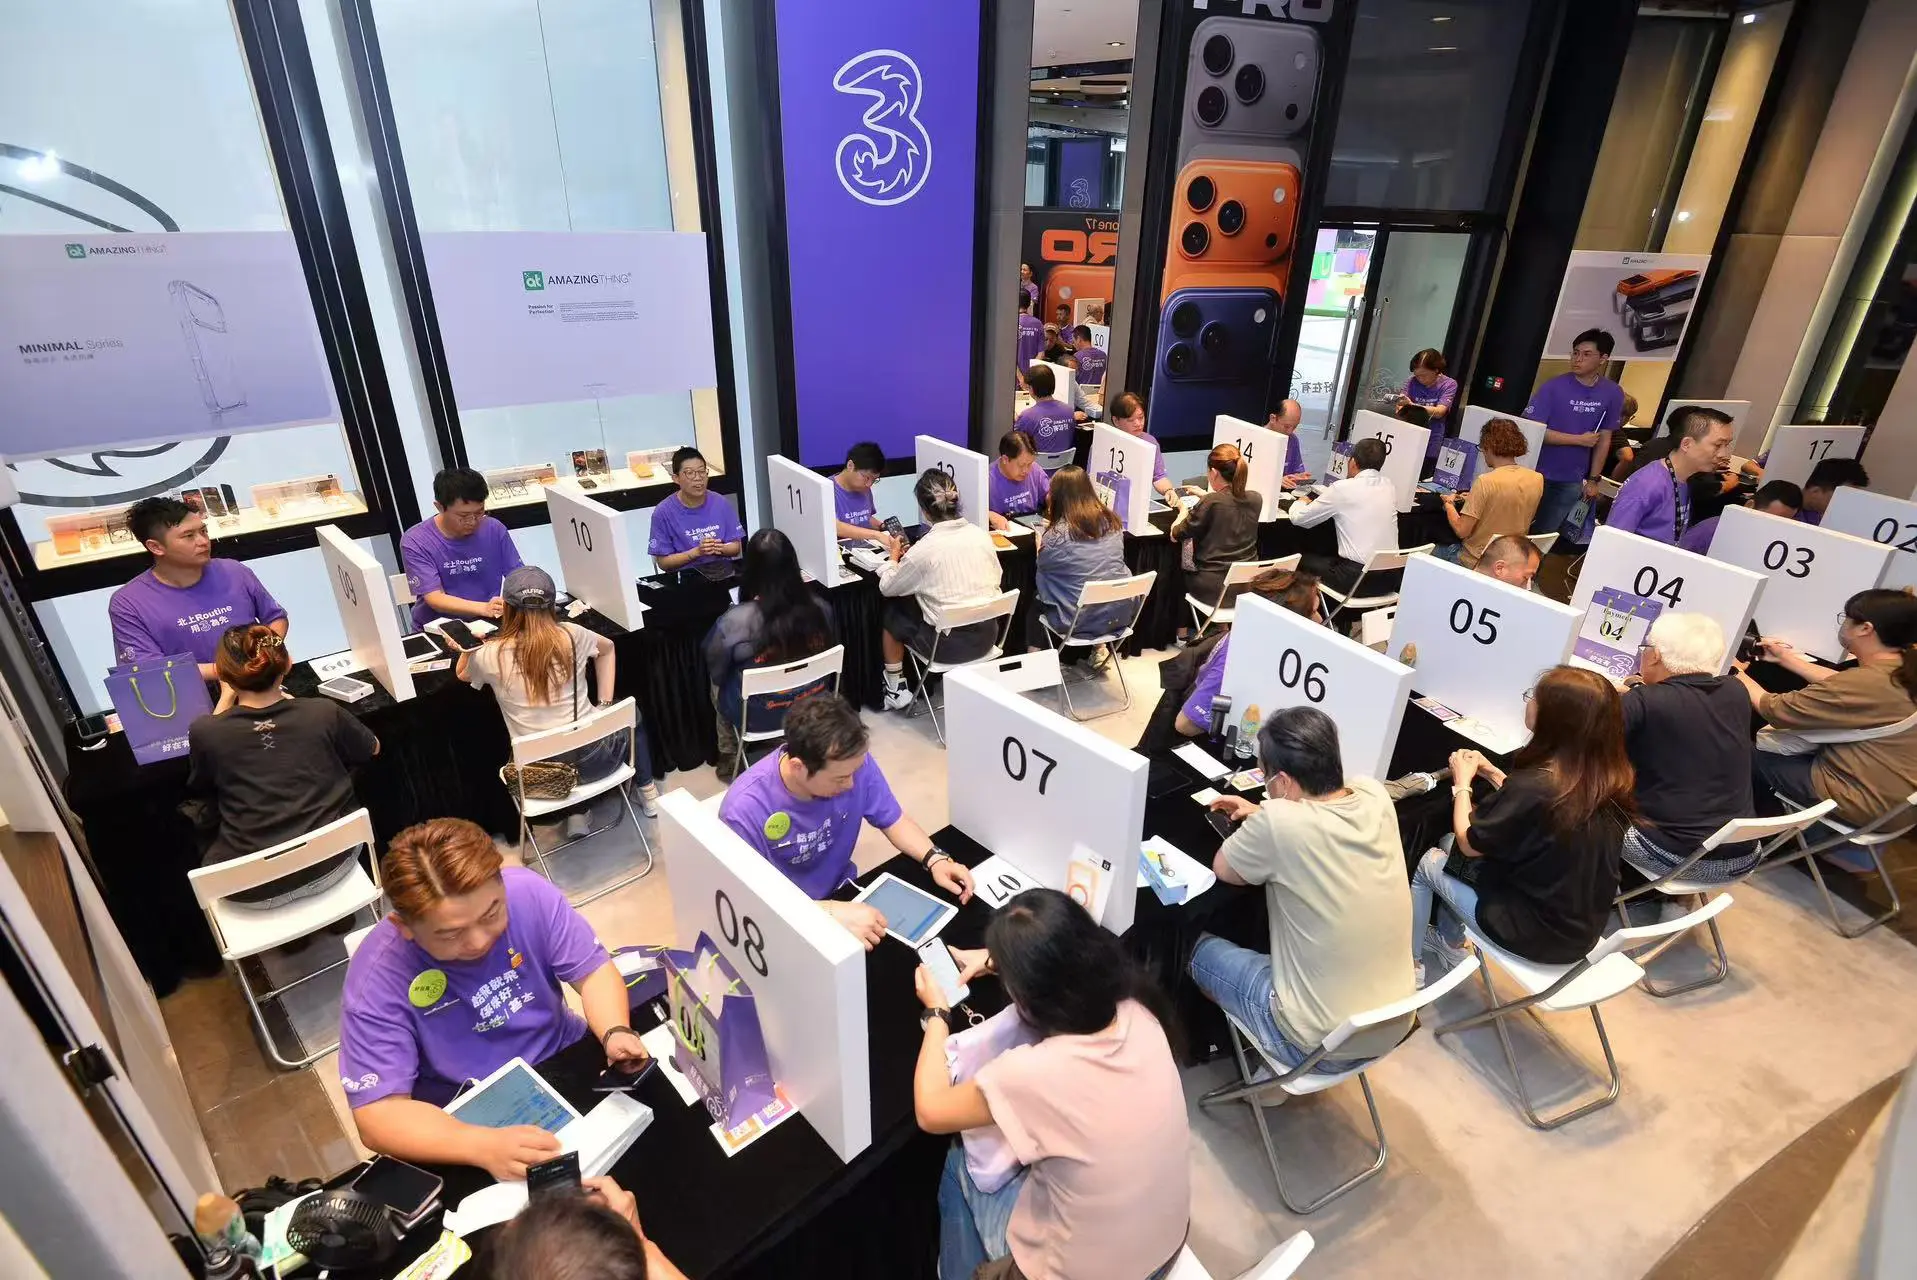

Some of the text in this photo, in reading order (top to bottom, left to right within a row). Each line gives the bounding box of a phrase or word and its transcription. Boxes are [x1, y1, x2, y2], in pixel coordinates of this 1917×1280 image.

[19, 339, 123, 354] MINIMAL Series
[1110, 447, 1125, 474] 13
[1236, 438, 1253, 463] 14
[1444, 457, 1456, 469] 16
[1809, 440, 1834, 460] 17
[787, 483, 803, 515] 11
[570, 517, 593, 552] 10
[1873, 517, 1917, 554] 02
[1763, 540, 1815, 578] 03
[337, 564, 358, 607] 09
[1633, 566, 1685, 609] 04
[177, 605, 233, 626] 北上Routine
[1449, 598, 1501, 645] 05
[1600, 621, 1624, 641] 04
[1603, 608, 1632, 622] Payment
[1278, 648, 1330, 703] 06
[1003, 736, 1058, 796] 07
[986, 874, 1022, 903] 07
[715, 889, 769, 978] 08
